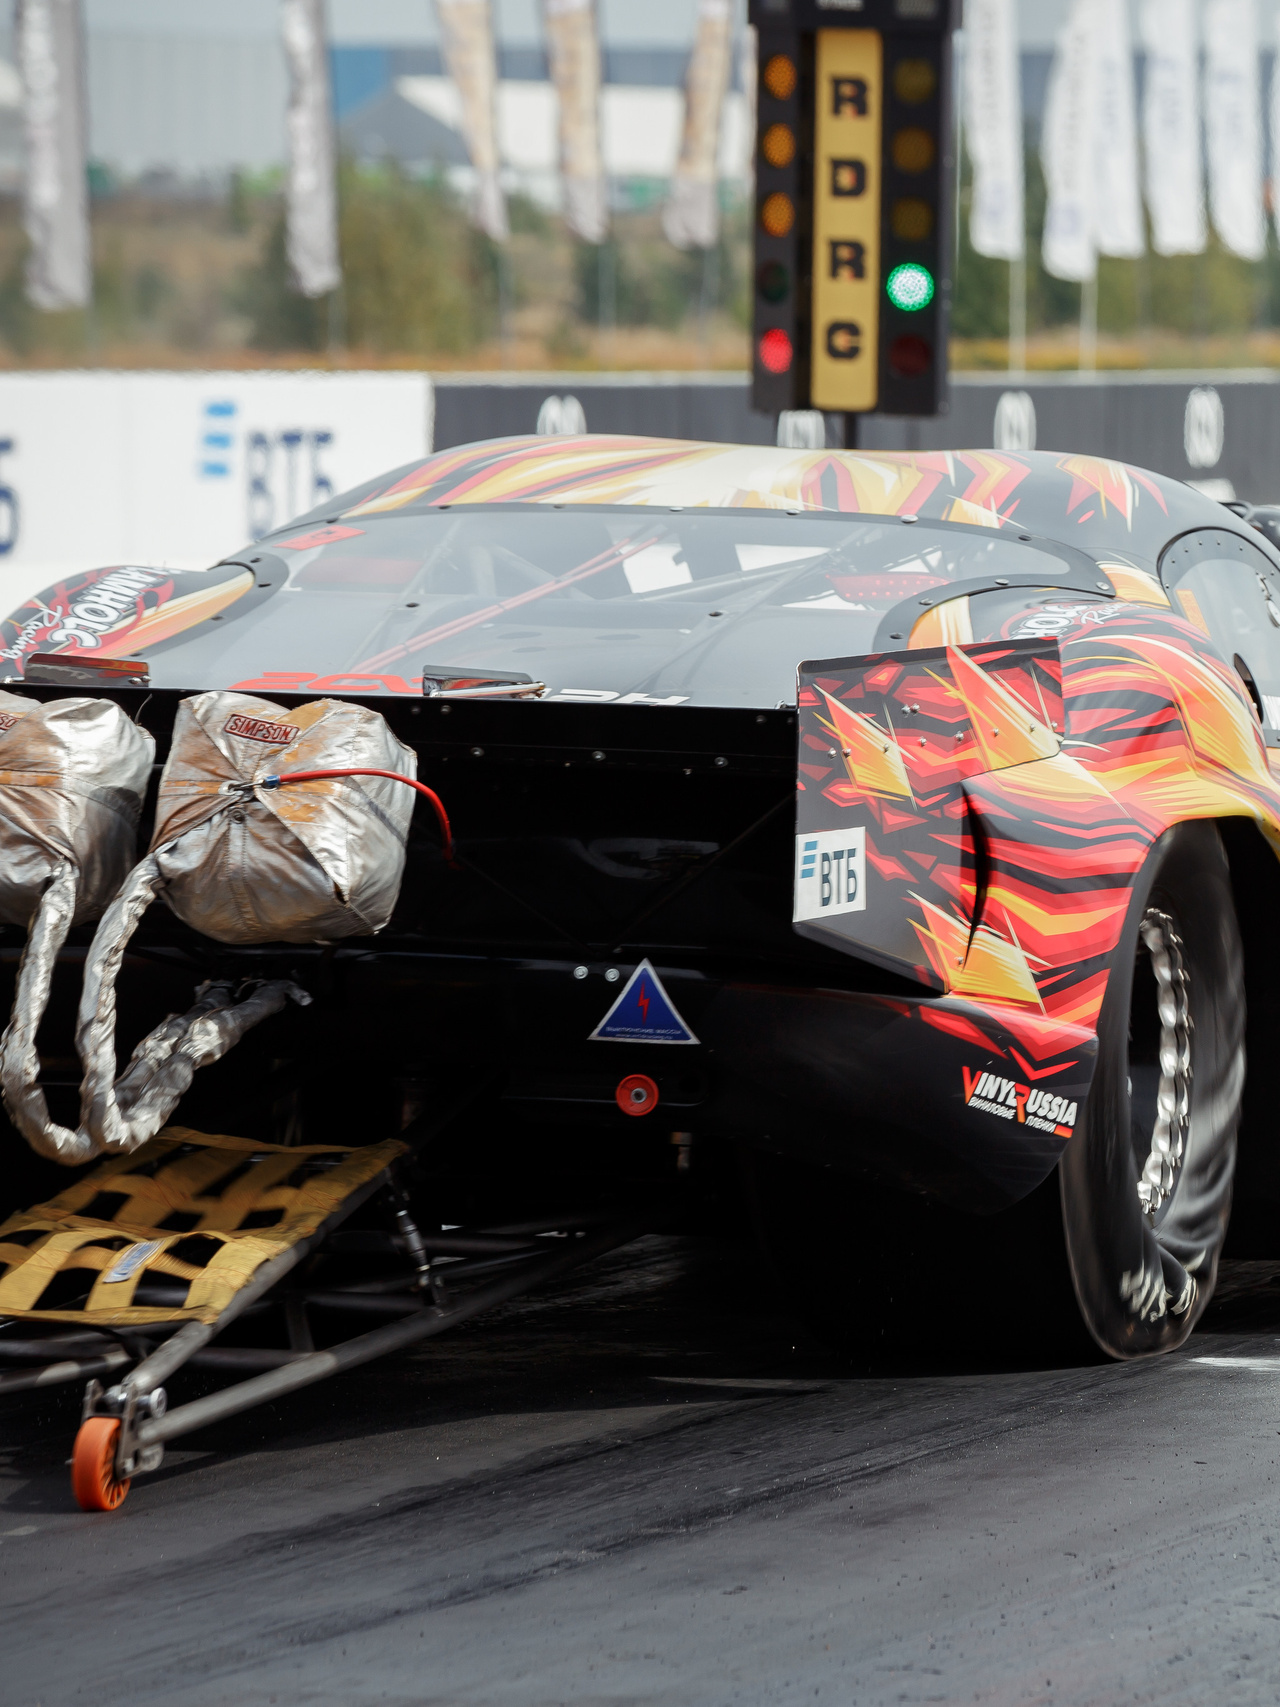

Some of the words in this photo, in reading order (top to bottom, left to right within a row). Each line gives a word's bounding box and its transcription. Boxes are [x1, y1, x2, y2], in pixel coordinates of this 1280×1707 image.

[826, 74, 869, 361] RDRC
[229, 716, 295, 741] SIMPSON
[821, 848, 857, 907] ВТБ
